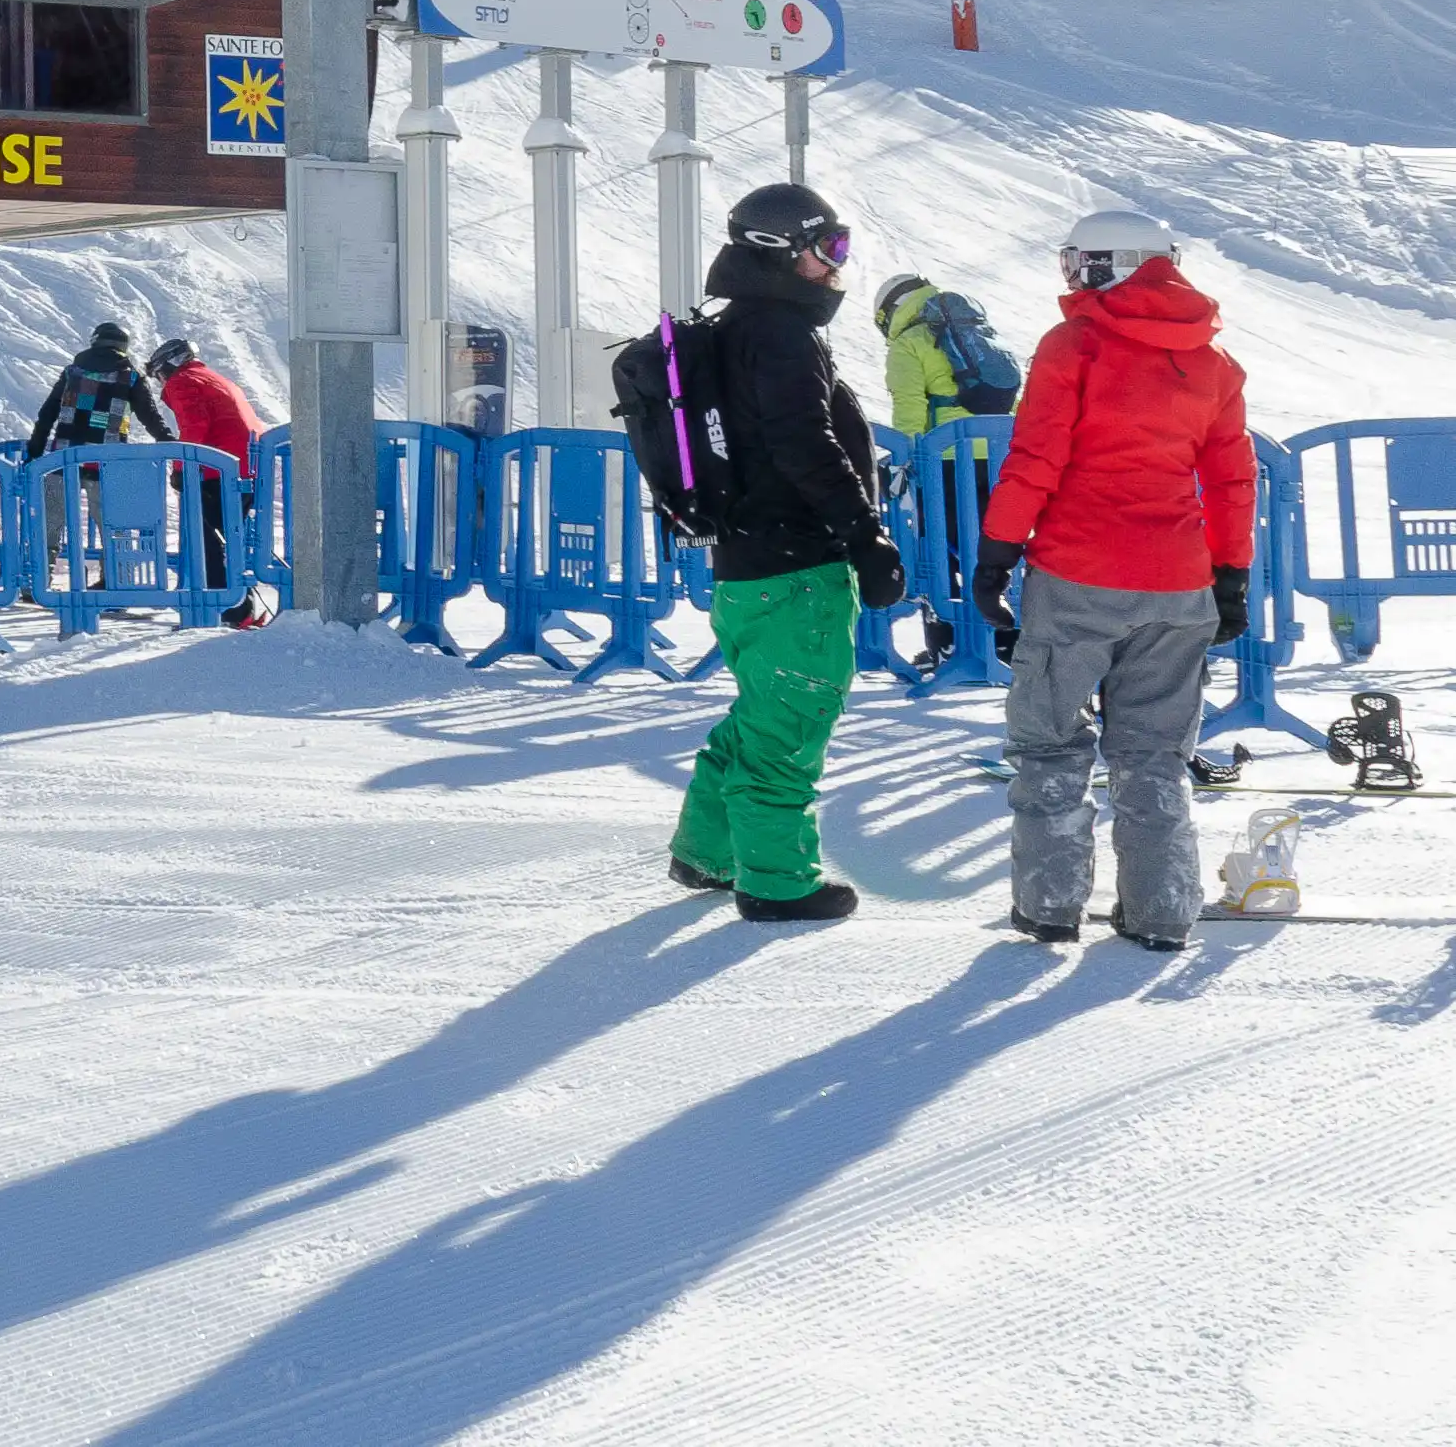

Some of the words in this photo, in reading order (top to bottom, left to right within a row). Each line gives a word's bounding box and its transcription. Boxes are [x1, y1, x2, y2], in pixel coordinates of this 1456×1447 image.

[208, 37, 258, 55] SAINTE
[262, 40, 283, 57] FO
[210, 143, 287, 153] TARENTAIS
[705, 408, 729, 460] ABS
